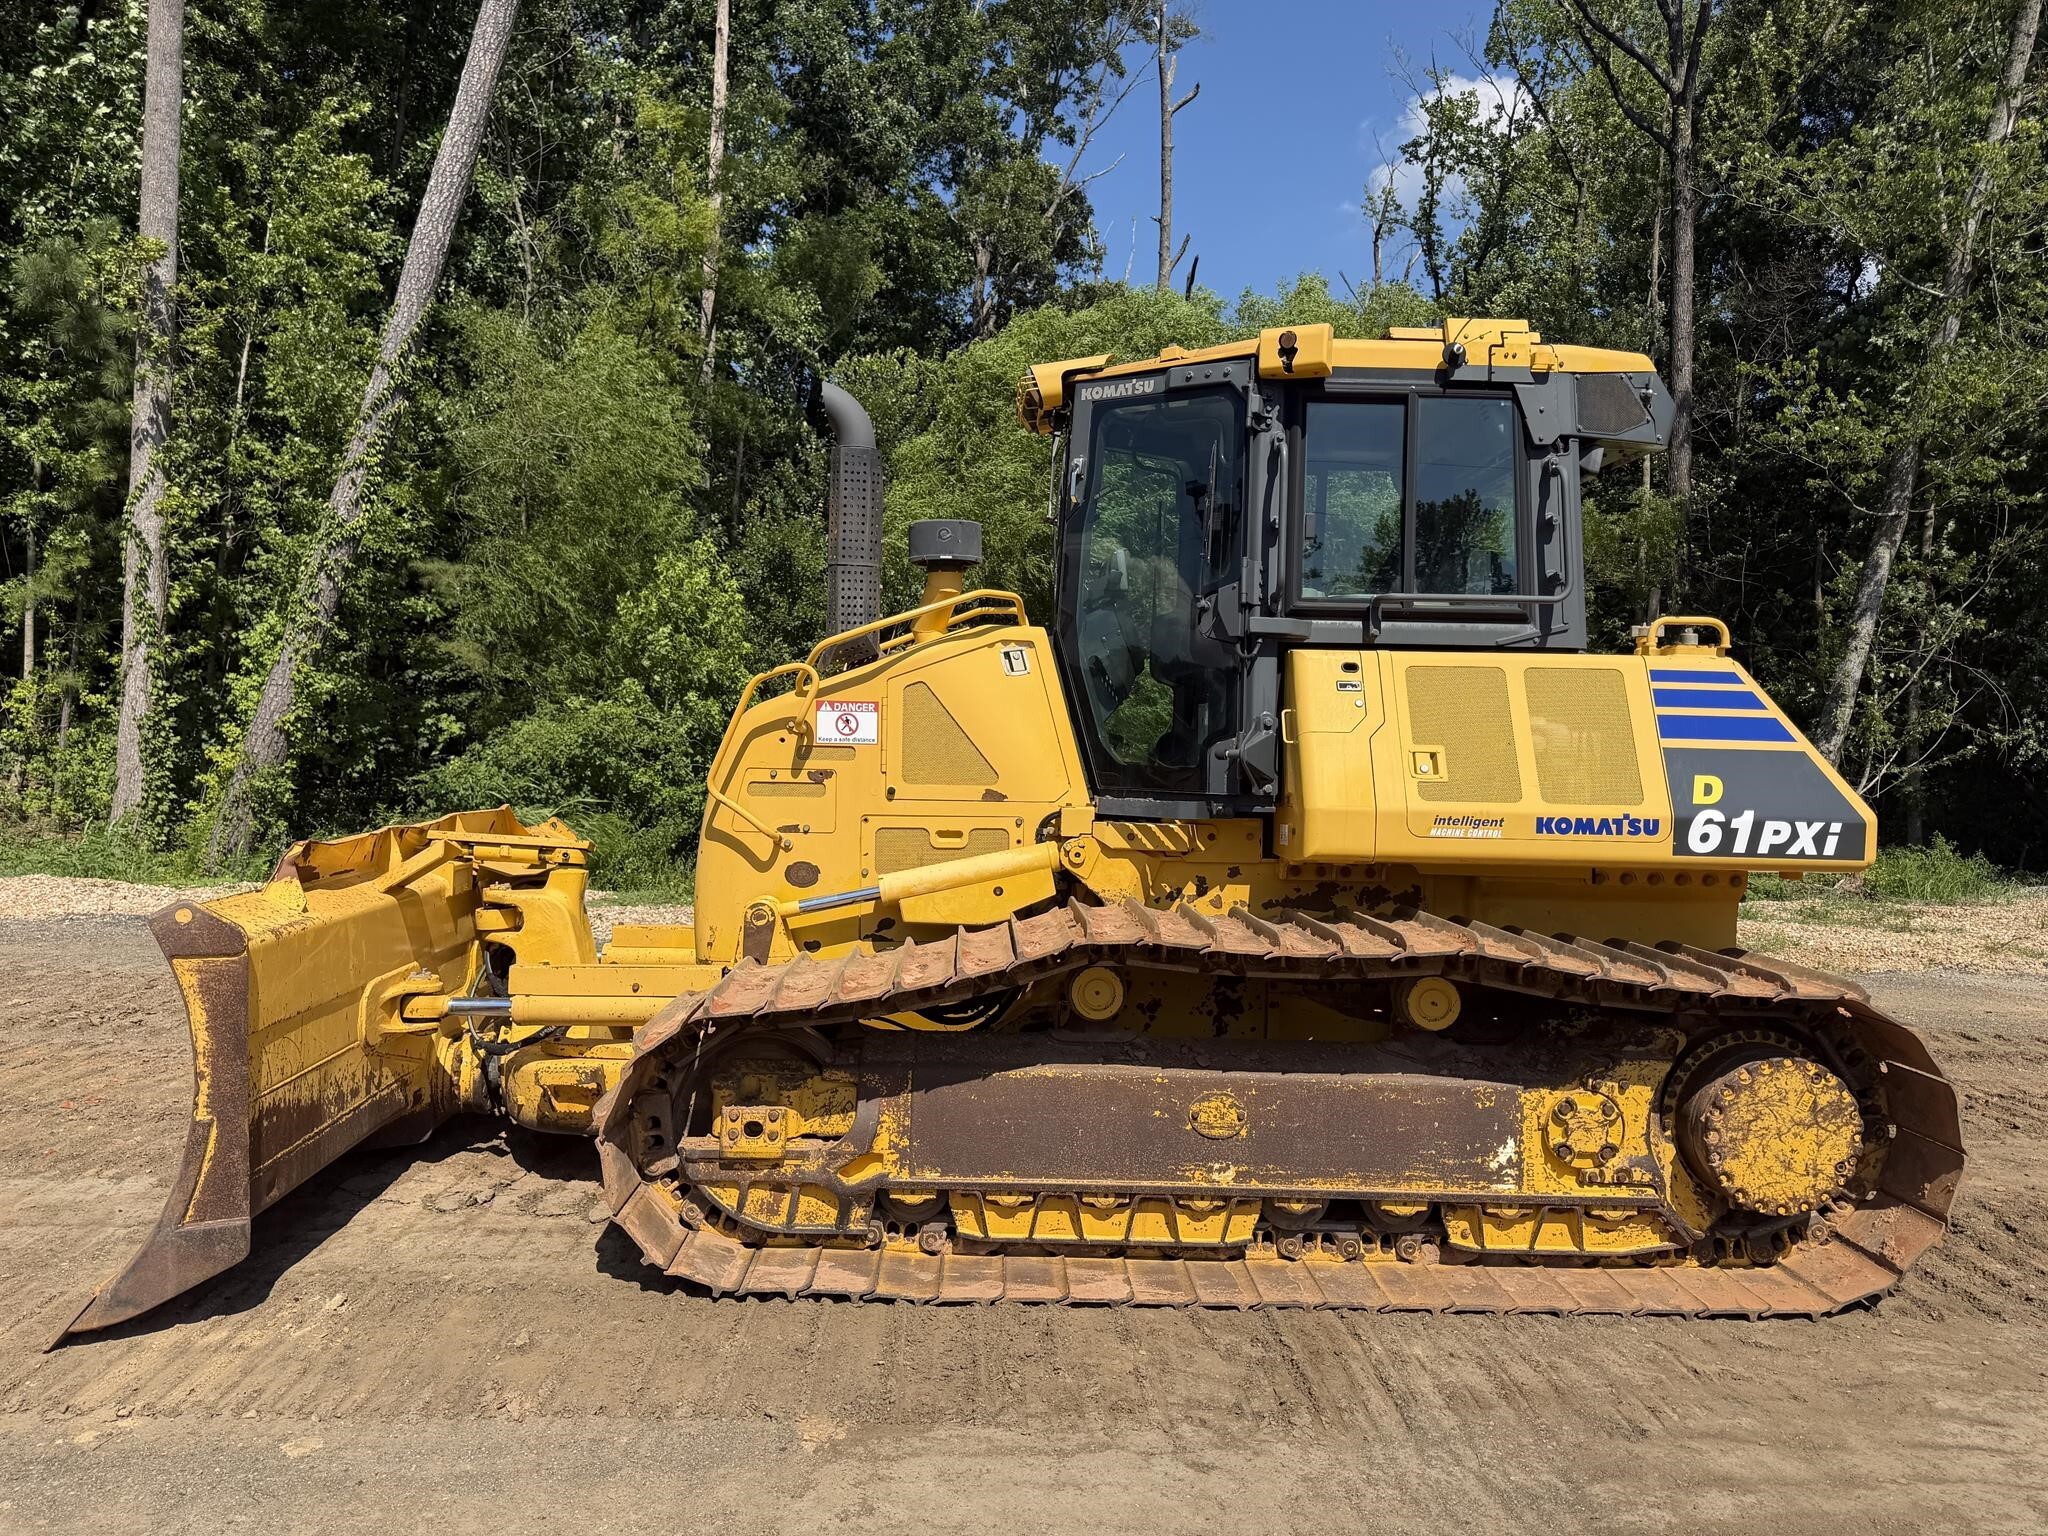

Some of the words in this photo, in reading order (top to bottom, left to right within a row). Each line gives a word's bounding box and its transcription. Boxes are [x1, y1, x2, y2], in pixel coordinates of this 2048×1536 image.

[1081, 378, 1155, 400] KOMATSU
[833, 702, 876, 712] DANGER
[1692, 774, 1724, 805] D
[1433, 814, 1505, 829] intelligent
[1536, 813, 1660, 836] KOMATSU
[1430, 827, 1465, 837] MACHINE
[1467, 829, 1502, 838] CONTROL
